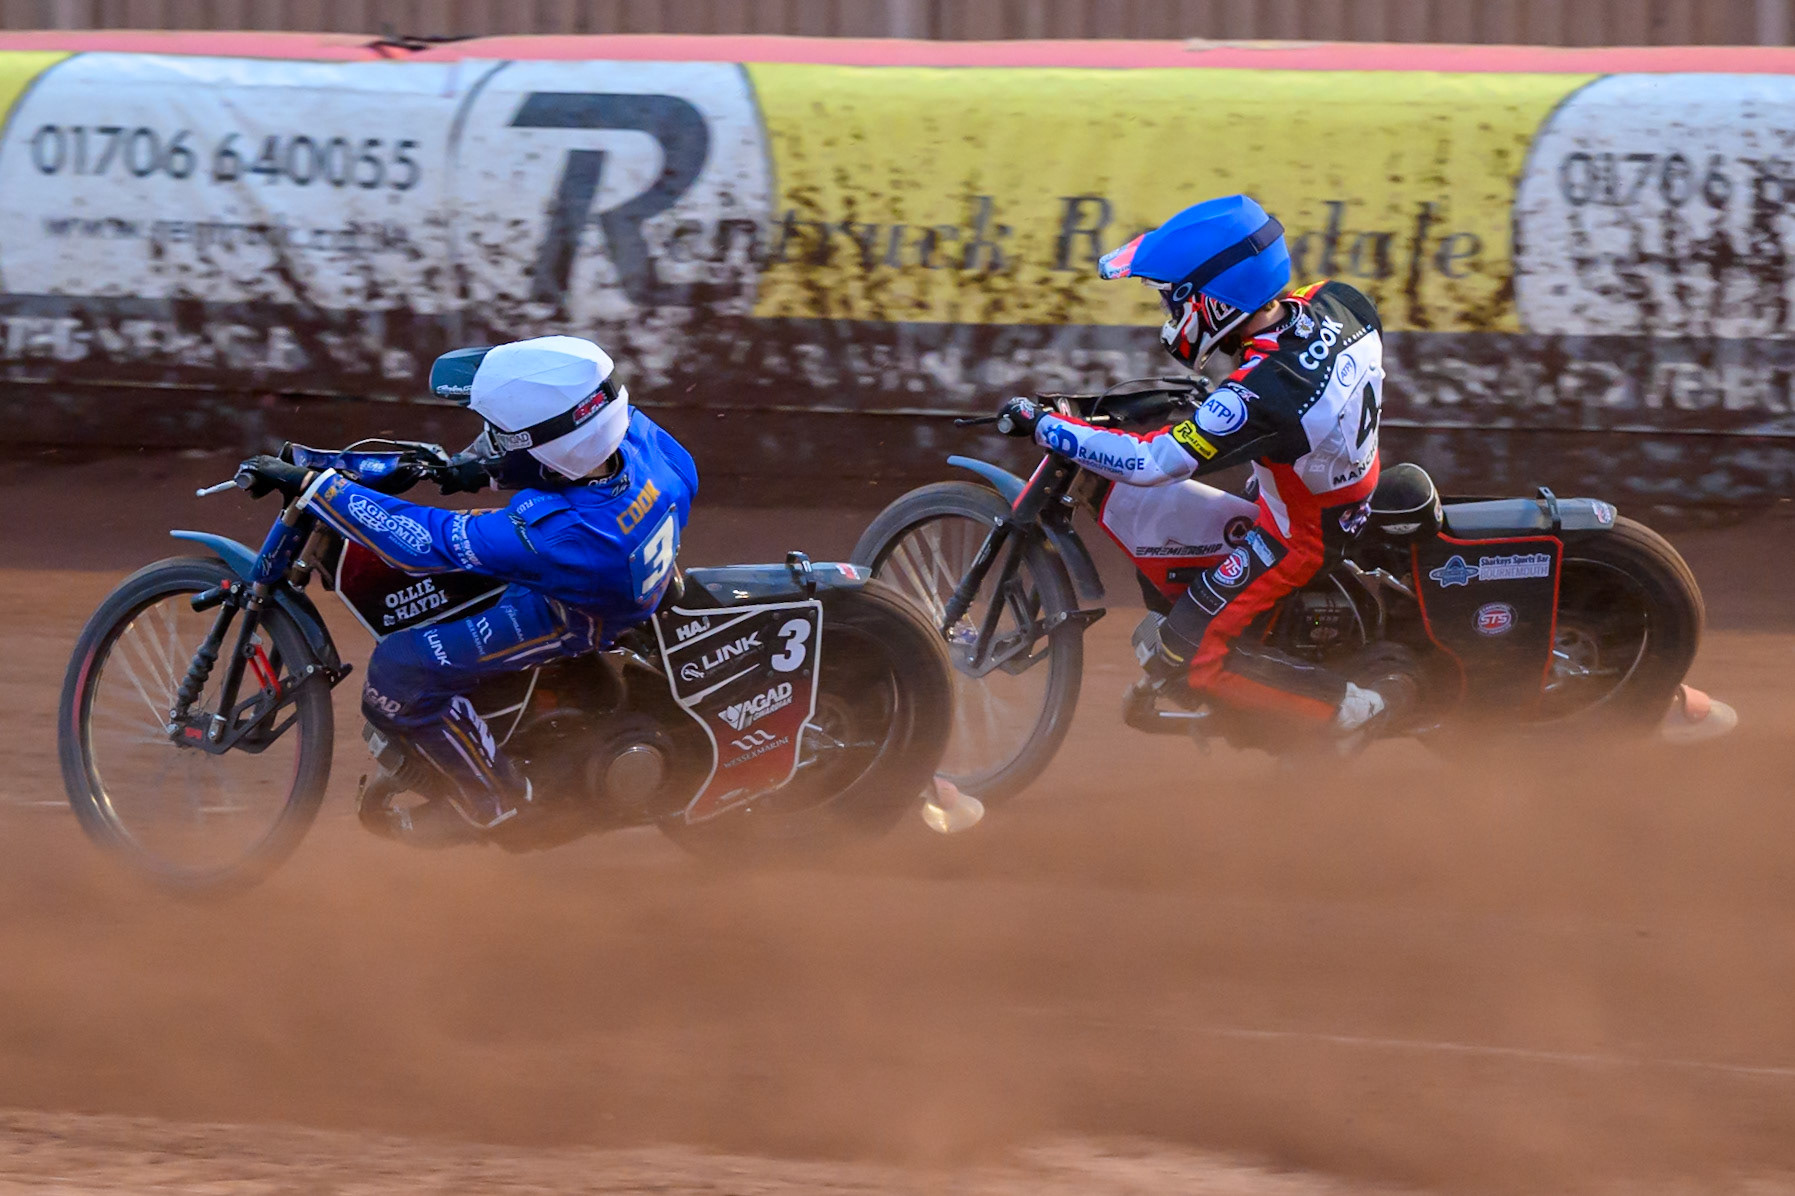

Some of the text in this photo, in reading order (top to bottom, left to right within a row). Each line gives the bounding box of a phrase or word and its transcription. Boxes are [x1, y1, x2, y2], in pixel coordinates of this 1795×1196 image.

[31, 123, 422, 191] 01706 640055
[1298, 315, 1344, 371] COOK
[1203, 398, 1236, 425] ATPI
[1356, 381, 1382, 450] 4
[356, 498, 428, 552] AGROMIX
[616, 479, 662, 536] COOK
[640, 514, 675, 595] 3
[385, 577, 436, 608] OLLIE
[395, 590, 449, 622] HAYDI
[1480, 612, 1509, 626] STS
[427, 633, 452, 666] LINK
[701, 630, 764, 671] LINK
[770, 618, 812, 673] 3
